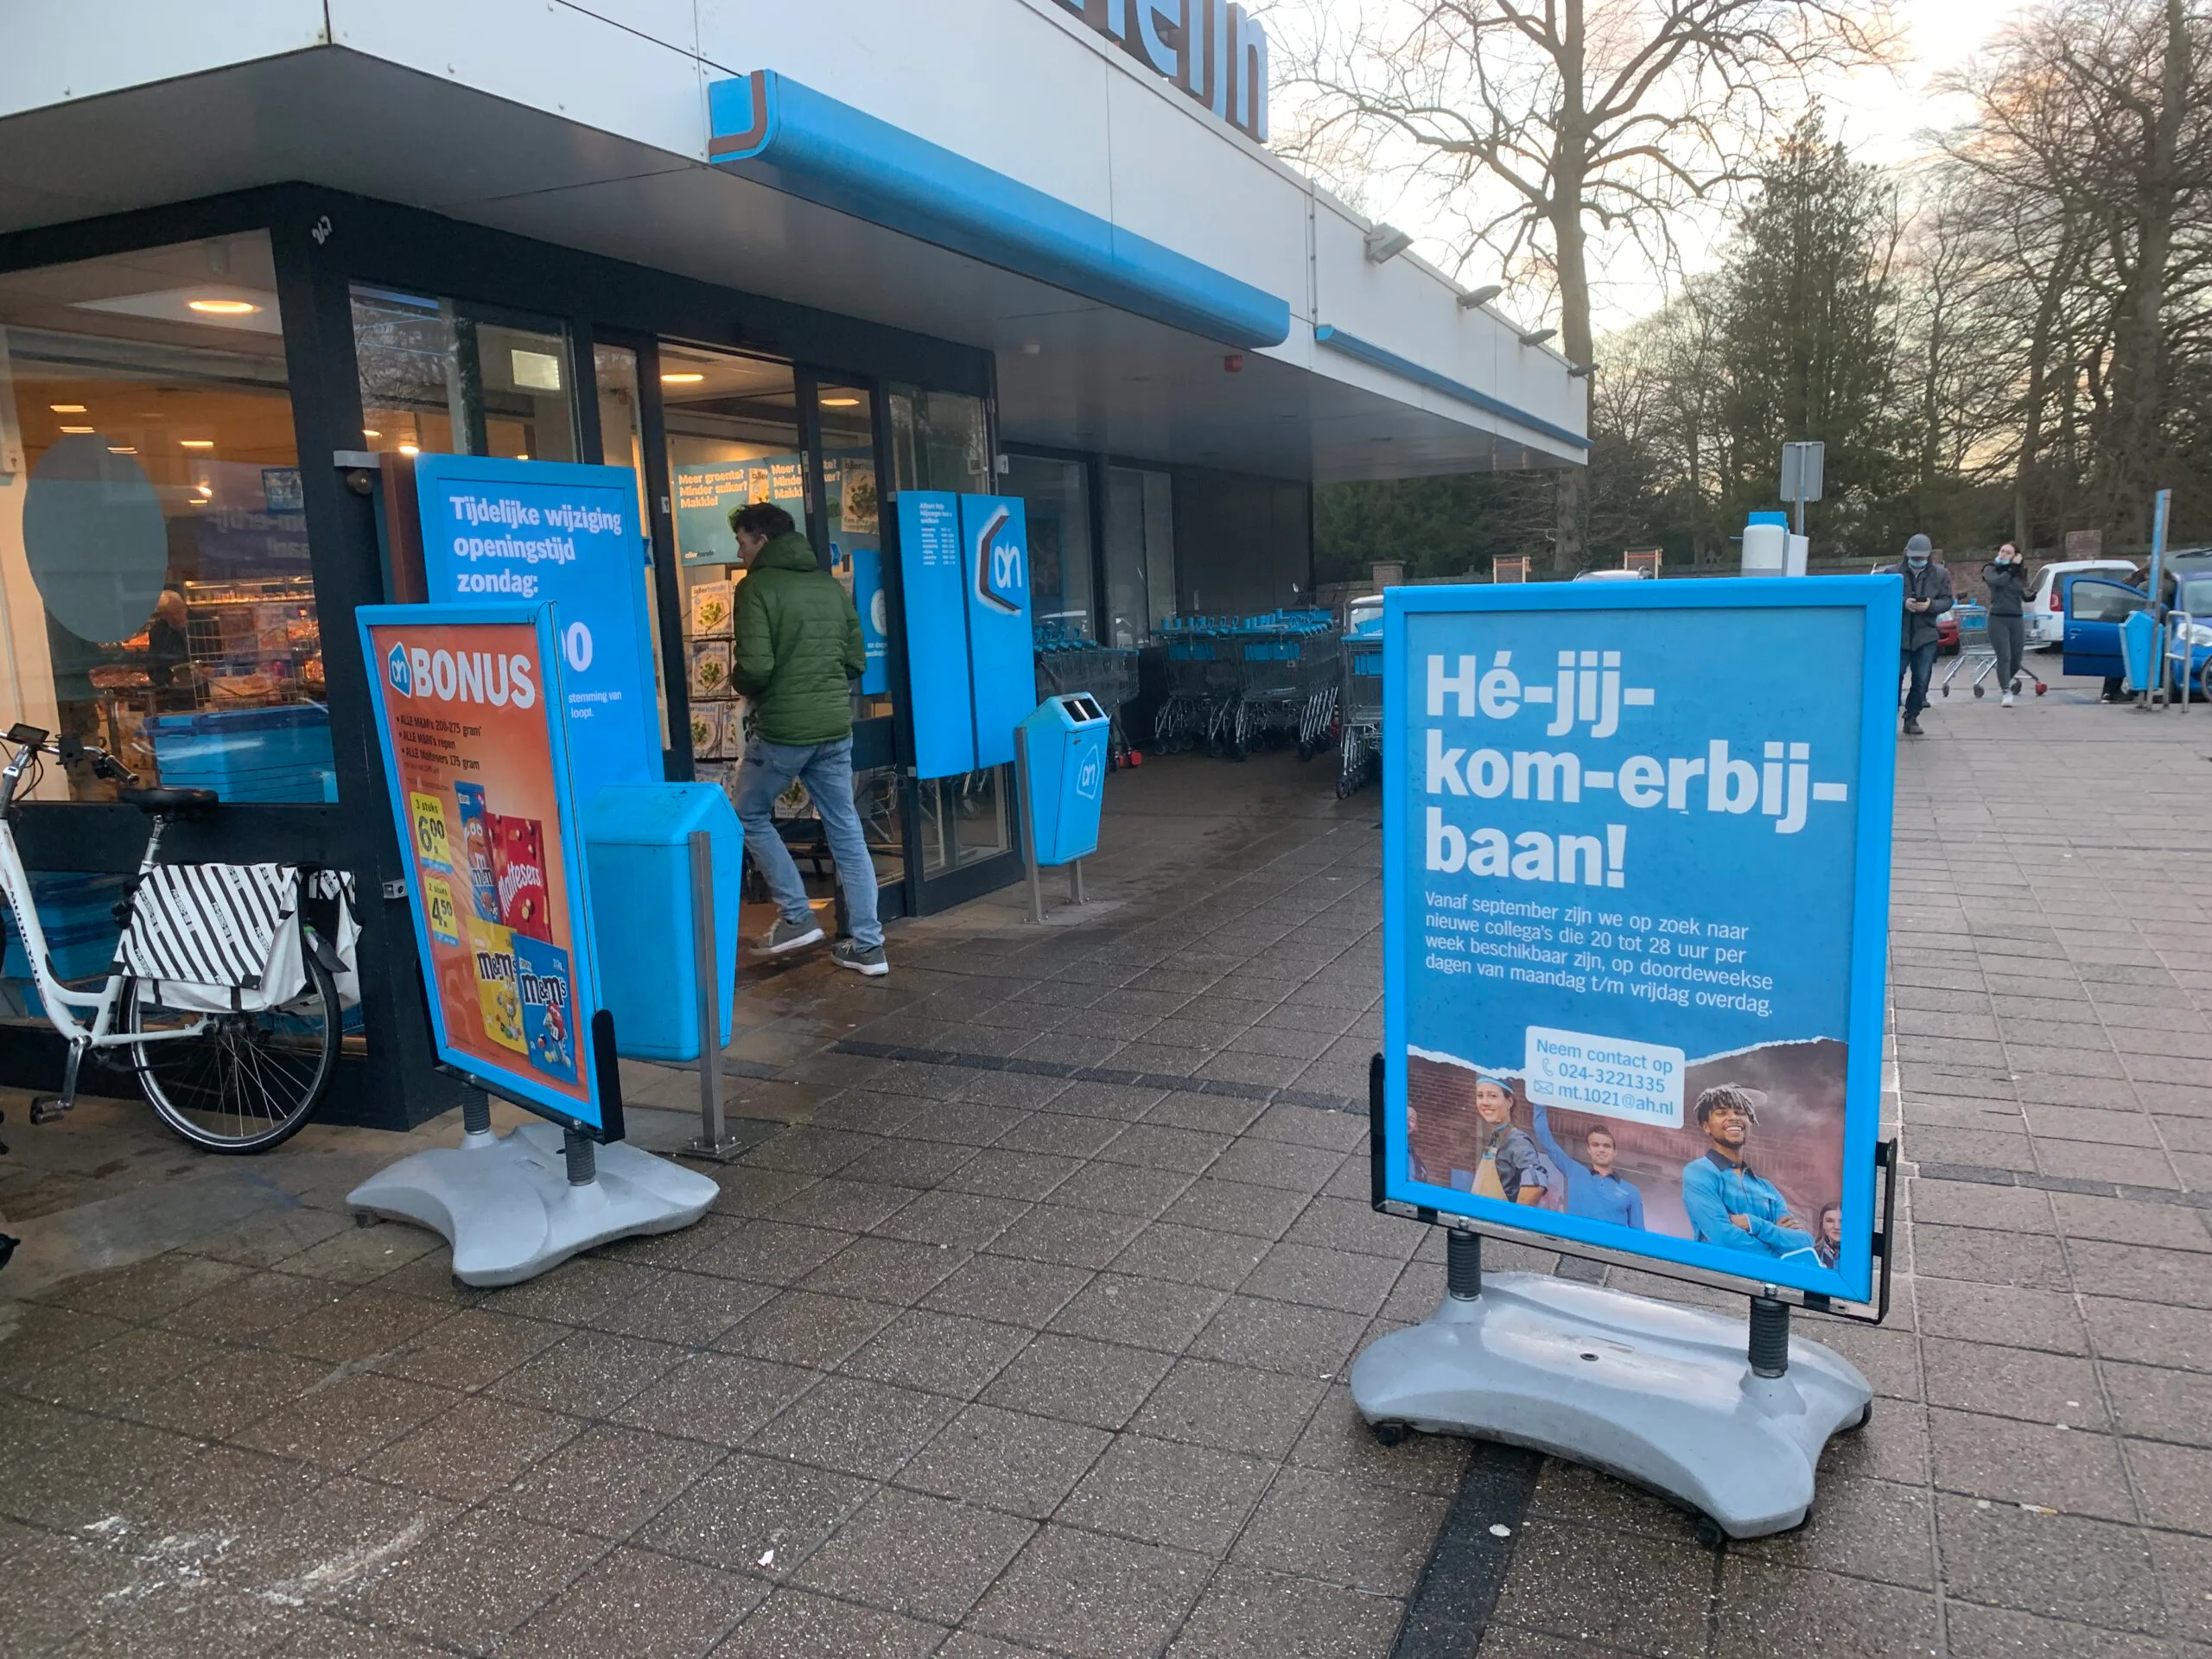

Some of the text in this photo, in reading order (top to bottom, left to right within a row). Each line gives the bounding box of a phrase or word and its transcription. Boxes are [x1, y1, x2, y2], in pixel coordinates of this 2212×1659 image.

[678, 469, 744, 485] Meer groente?
[680, 485, 713, 497] Minder
[449, 496, 623, 536] Tijdelijke wijziging
[454, 534, 576, 564] openingstijd
[457, 569, 539, 598] zondag:
[561, 621, 594, 673] 0
[410, 647, 536, 709] BONUS
[608, 691, 622, 701] van
[1427, 651, 1655, 739] Hé-jij-
[435, 720, 461, 734] 200-275
[571, 707, 594, 720] loopt.
[438, 739, 456, 751] repen
[449, 754, 461, 766] 175
[462, 760, 480, 771] gram
[1426, 728, 1848, 834] kom-erbij-
[422, 802, 439, 814] stuks
[1426, 806, 1628, 888] baan!
[1426, 891, 1750, 940] Vanaf september zijn we op zoek naar
[1426, 912, 1747, 964] nieuwe collega's die 20 tot 28 uur per
[1426, 935, 1773, 990] week beschikbaar zijn, op doordeweekse
[1426, 953, 1773, 1017] dagen van maandag t/m vrijdag overdag.
[1536, 1039, 1674, 1076] Neem contact op
[1559, 1062, 1666, 1093] 024-3221335
[1559, 1084, 1674, 1116] mt.1021@ah.nl
